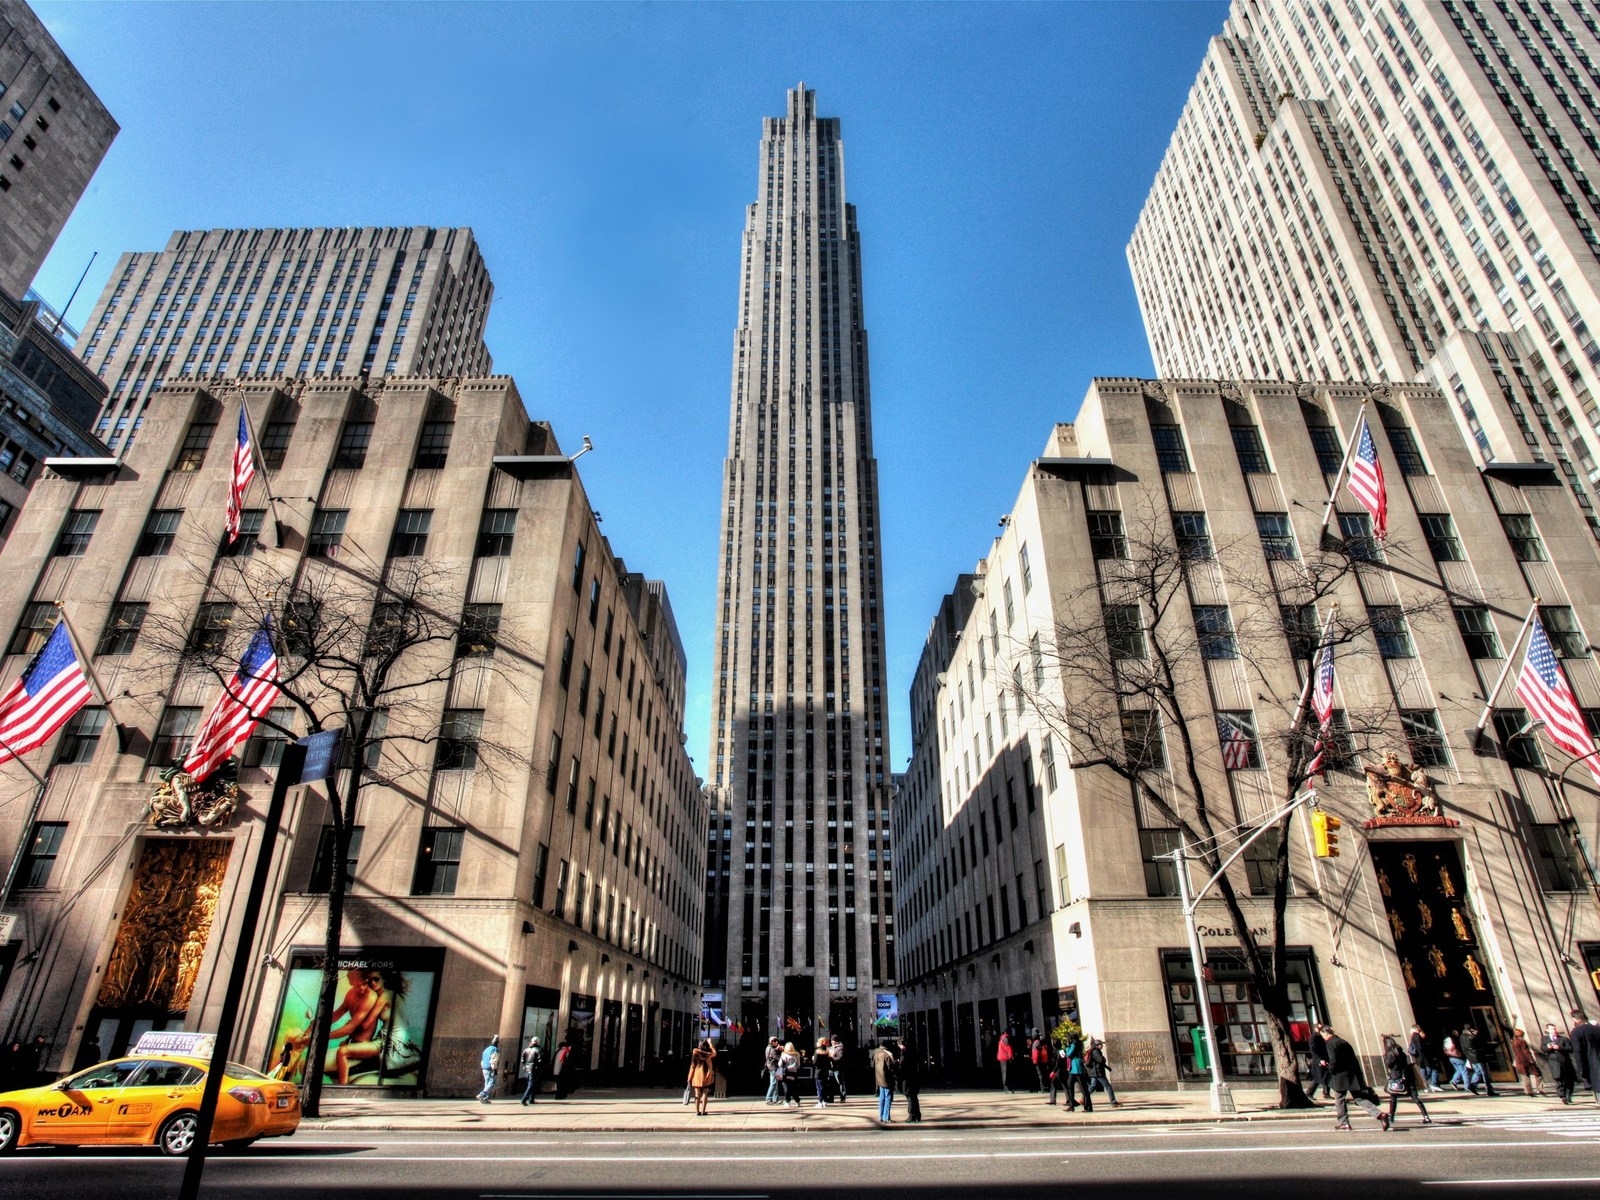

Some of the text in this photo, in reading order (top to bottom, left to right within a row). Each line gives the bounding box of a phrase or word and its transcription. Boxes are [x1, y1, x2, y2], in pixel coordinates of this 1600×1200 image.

[371, 961, 394, 969] KORS
[141, 1033, 198, 1045] PRIVATE EYES
[139, 1042, 177, 1050] GENTLEMEN'S
[57, 1103, 93, 1118] TAXI
